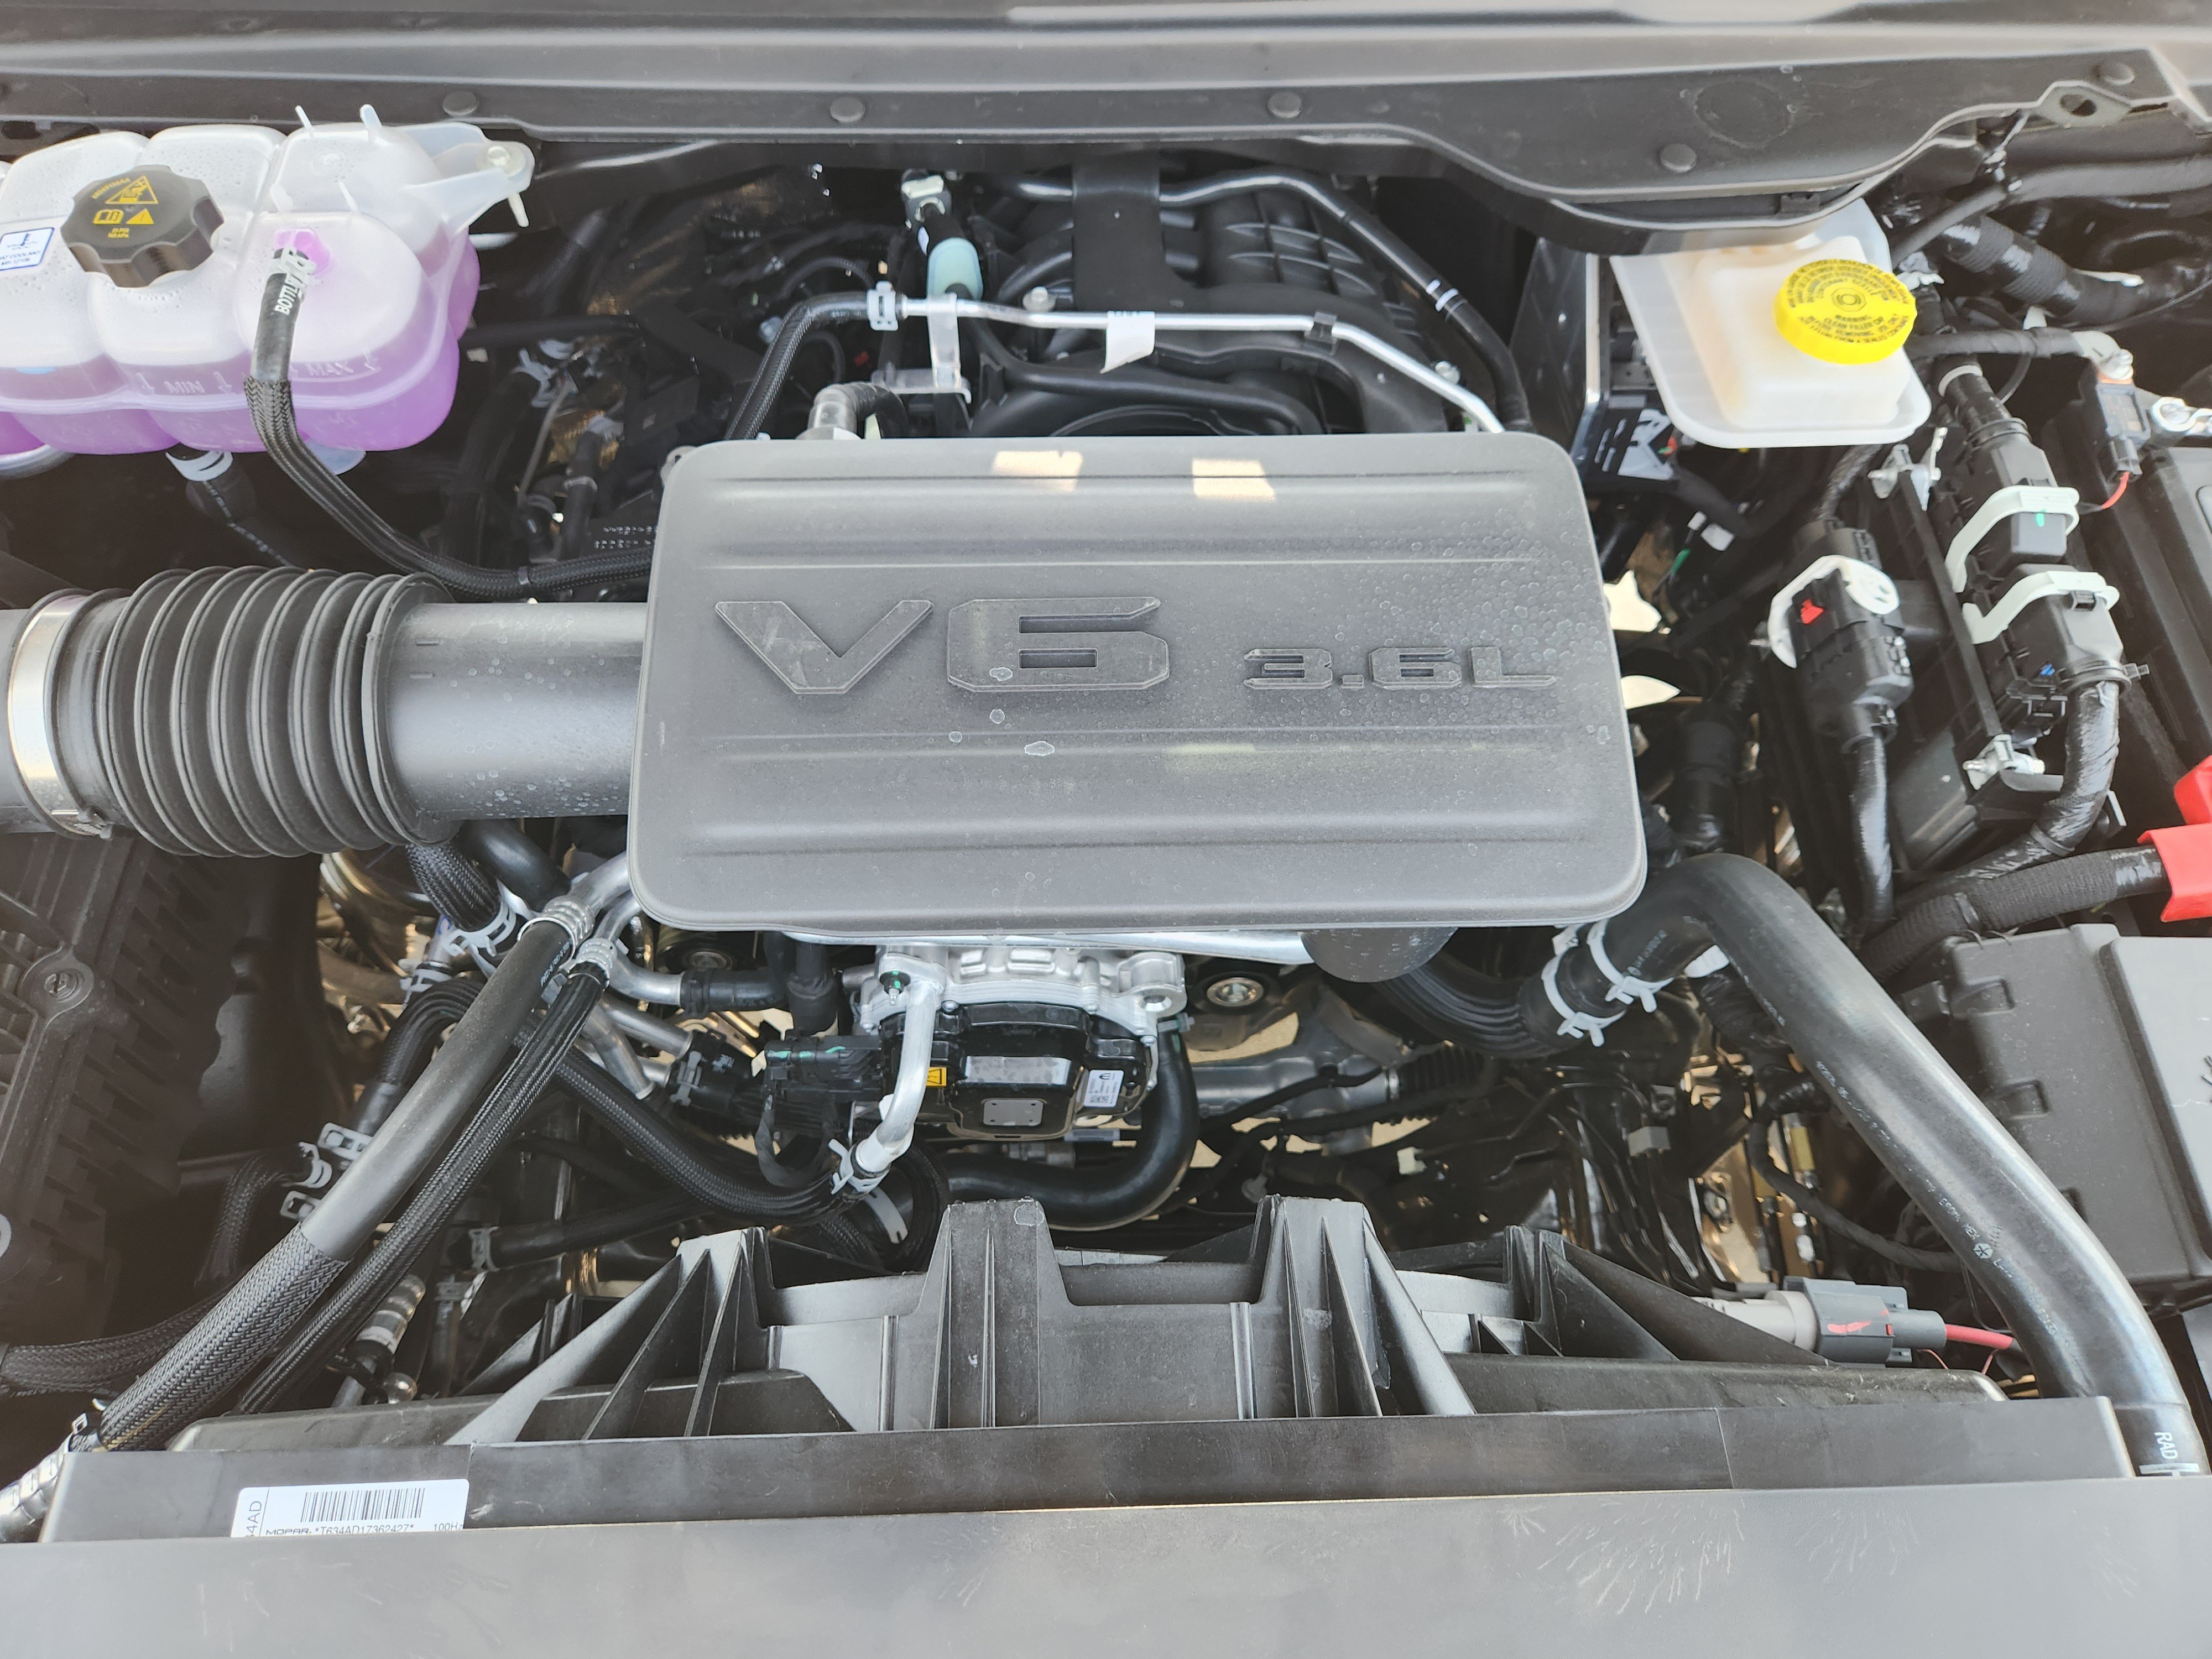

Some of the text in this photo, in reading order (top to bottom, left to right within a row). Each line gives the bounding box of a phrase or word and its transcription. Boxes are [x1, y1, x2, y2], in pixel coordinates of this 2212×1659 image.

[305, 362, 354, 377] MAX
[164, 380, 205, 394] MIN
[716, 596, 1557, 695] V6 3.6L
[2154, 1432, 2178, 1460] RAD
